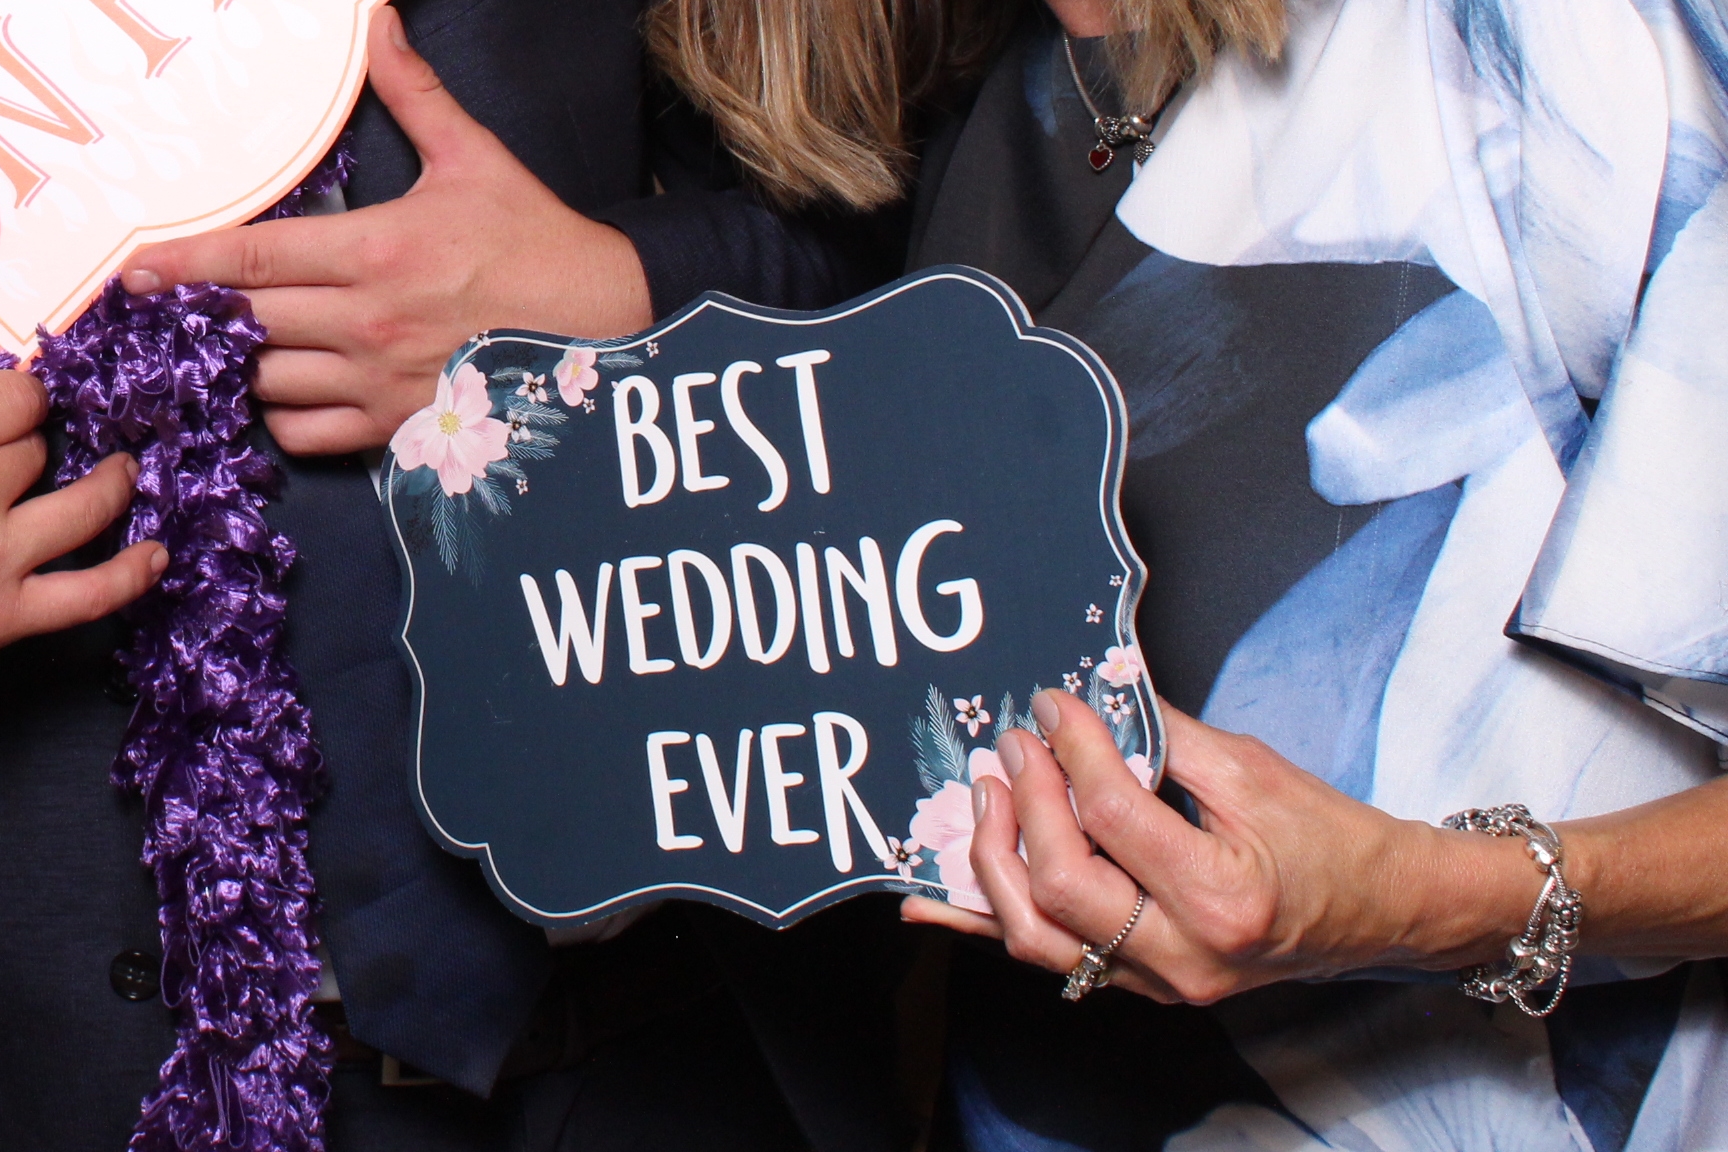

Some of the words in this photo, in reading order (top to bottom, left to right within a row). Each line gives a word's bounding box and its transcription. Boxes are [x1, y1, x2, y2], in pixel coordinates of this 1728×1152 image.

[612, 349, 831, 512] BEST
[519, 519, 984, 686] WEDDING
[646, 711, 892, 873] EVER
